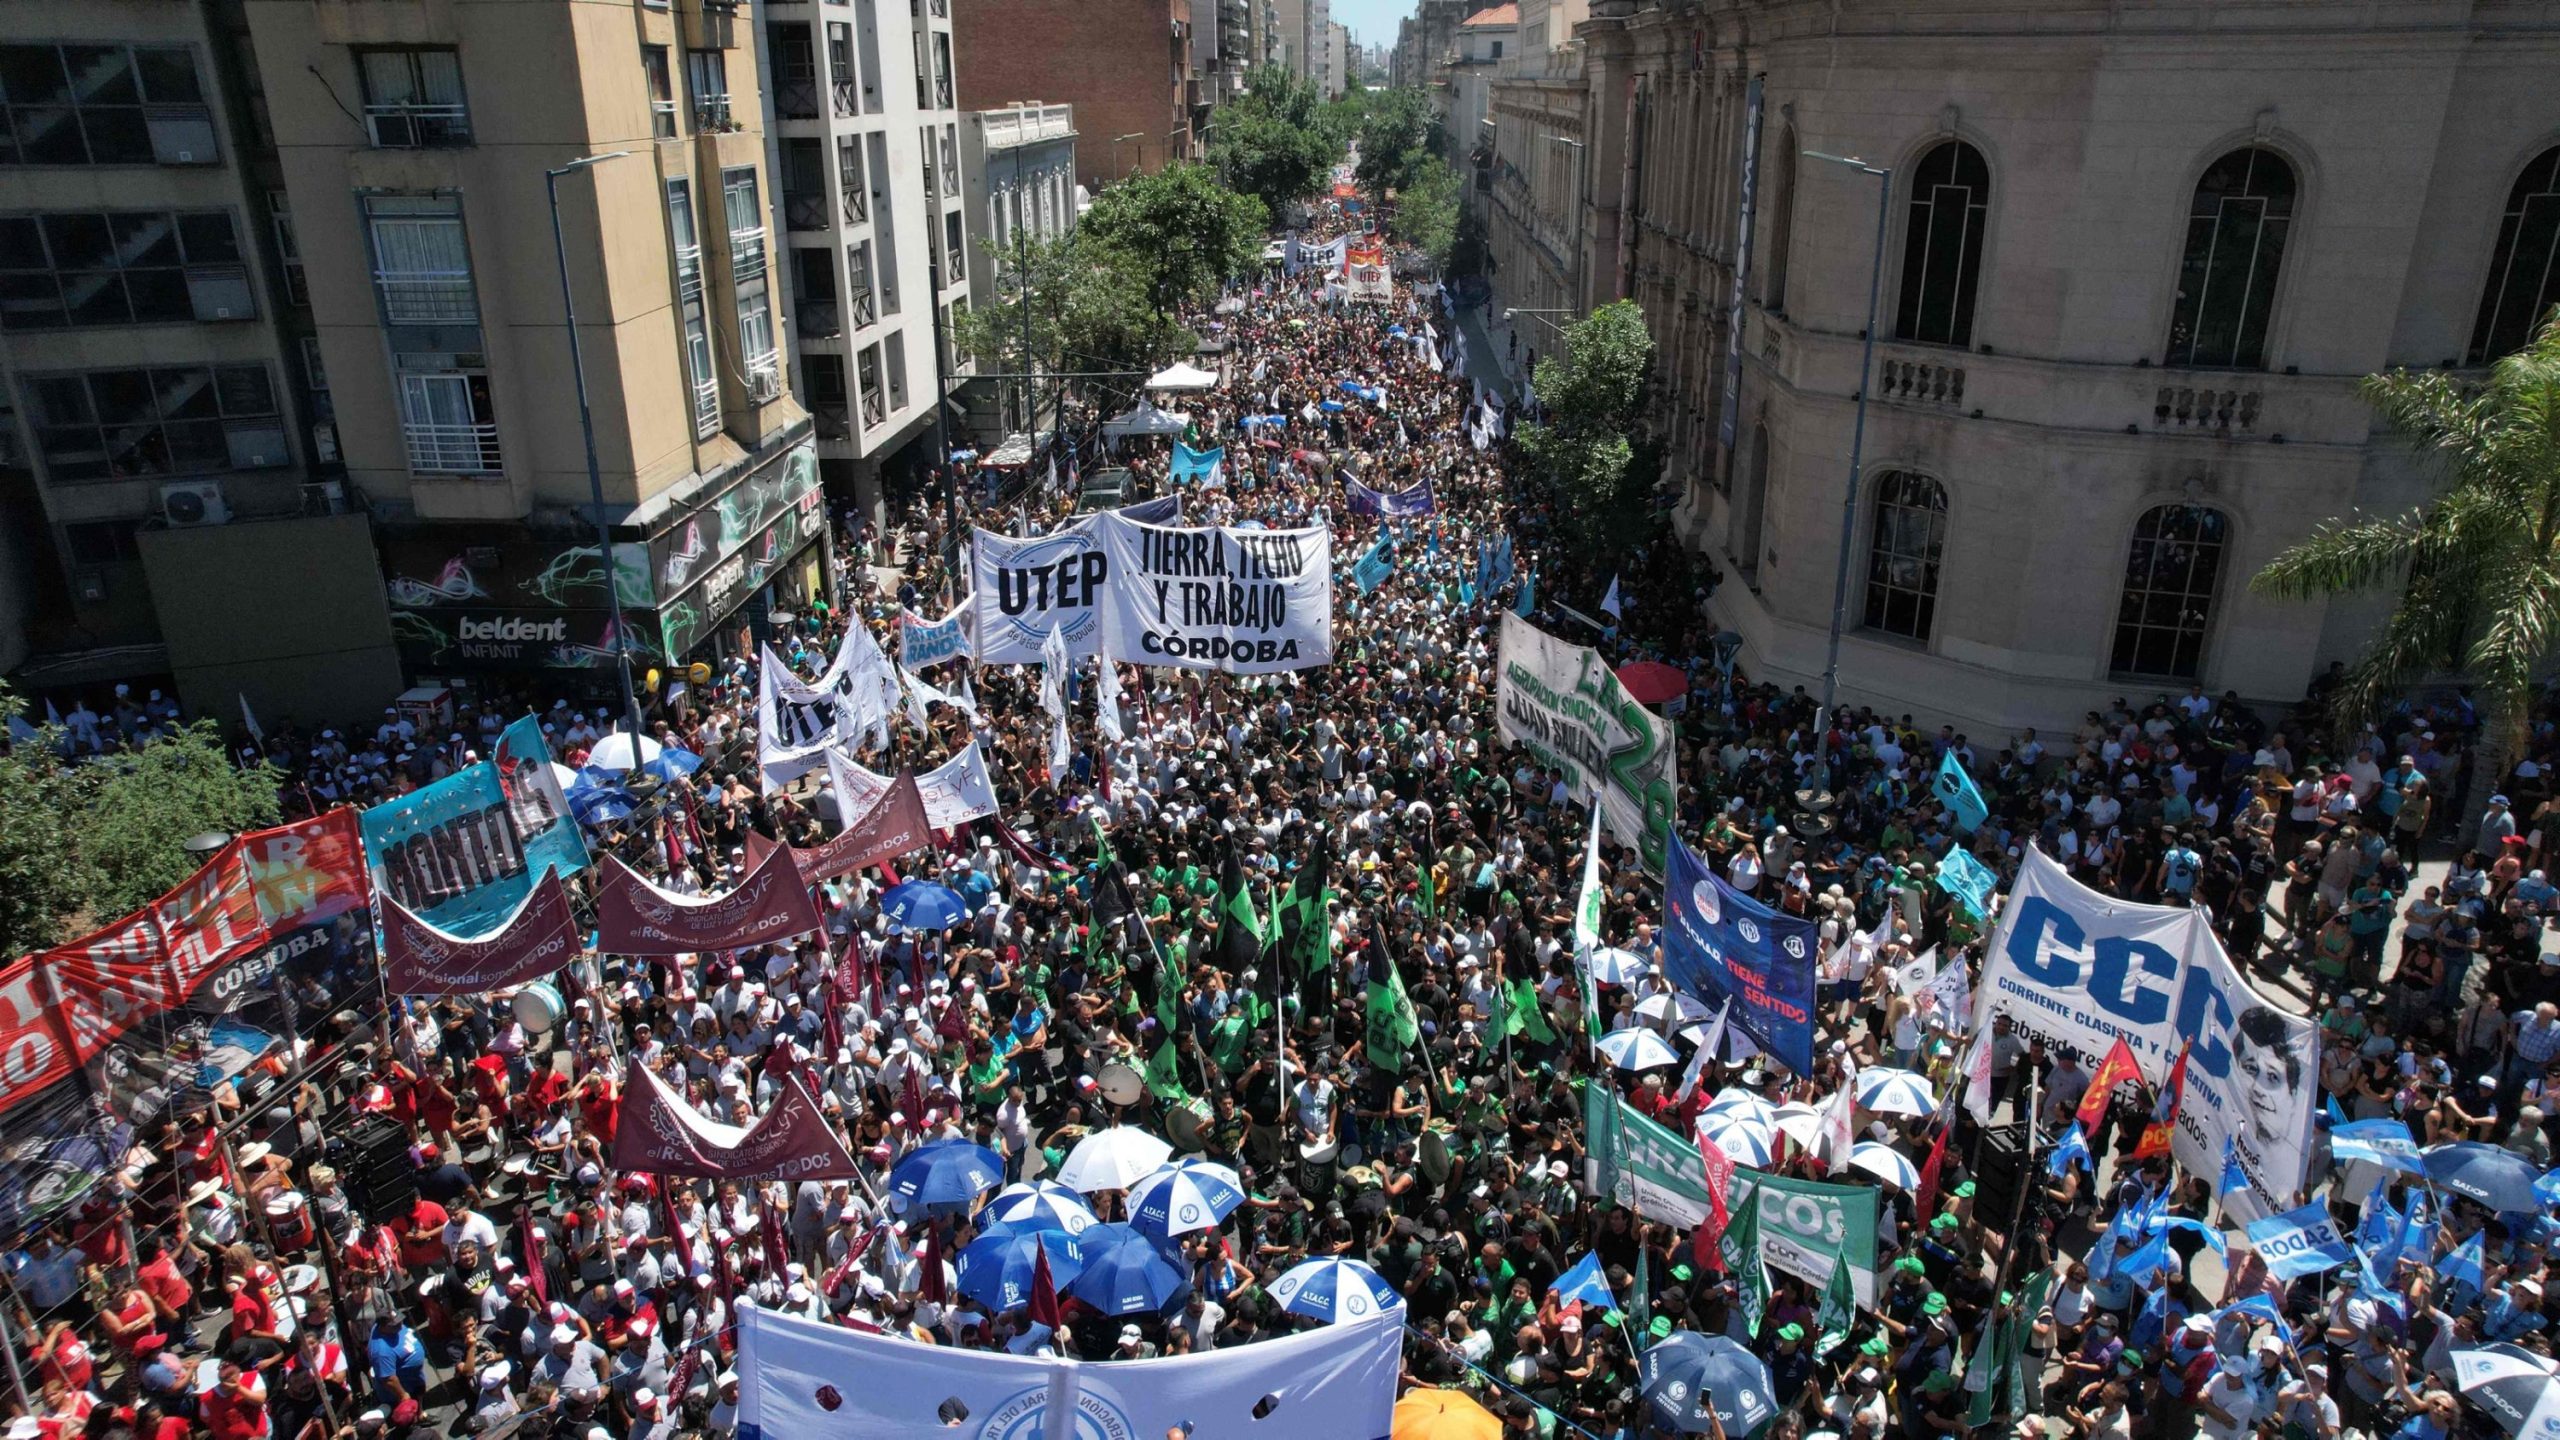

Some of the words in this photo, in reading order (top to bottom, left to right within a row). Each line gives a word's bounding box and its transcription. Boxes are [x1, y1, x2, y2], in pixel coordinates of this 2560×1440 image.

[1296, 249, 1335, 265] UTEP
[1360, 271, 1381, 282] UTEP
[1140, 527, 1234, 583] TIERRA,
[1236, 534, 1302, 579] TECHO
[998, 551, 1107, 615] UTEP
[1153, 580, 1170, 625] Y
[1179, 581, 1286, 634] TRABAJO
[460, 616, 567, 641] beldent
[1007, 630, 1018, 641] de
[1066, 620, 1097, 644] Popular
[1141, 630, 1300, 662] CÓRDOBA
[1506, 690, 1550, 740] JUAN
[1562, 696, 1608, 745] SINDICAL
[642, 926, 699, 945] Regional
[418, 966, 479, 985] Regional
[1726, 956, 1766, 989] TIENE
[2006, 896, 2235, 1078] CCC
[1744, 986, 1807, 1024] SENTIDO
[1999, 976, 2069, 1018] CORRIENTE
[2075, 1011, 2143, 1049] CLASISTA
[2150, 1041, 2159, 1055] Y
[2164, 1049, 2223, 1112] COBATIVA
[464, 1269, 491, 1290] ADIDAS
[1764, 1252, 1800, 1274] Regional
[2481, 1386, 2524, 1421] SADOP
